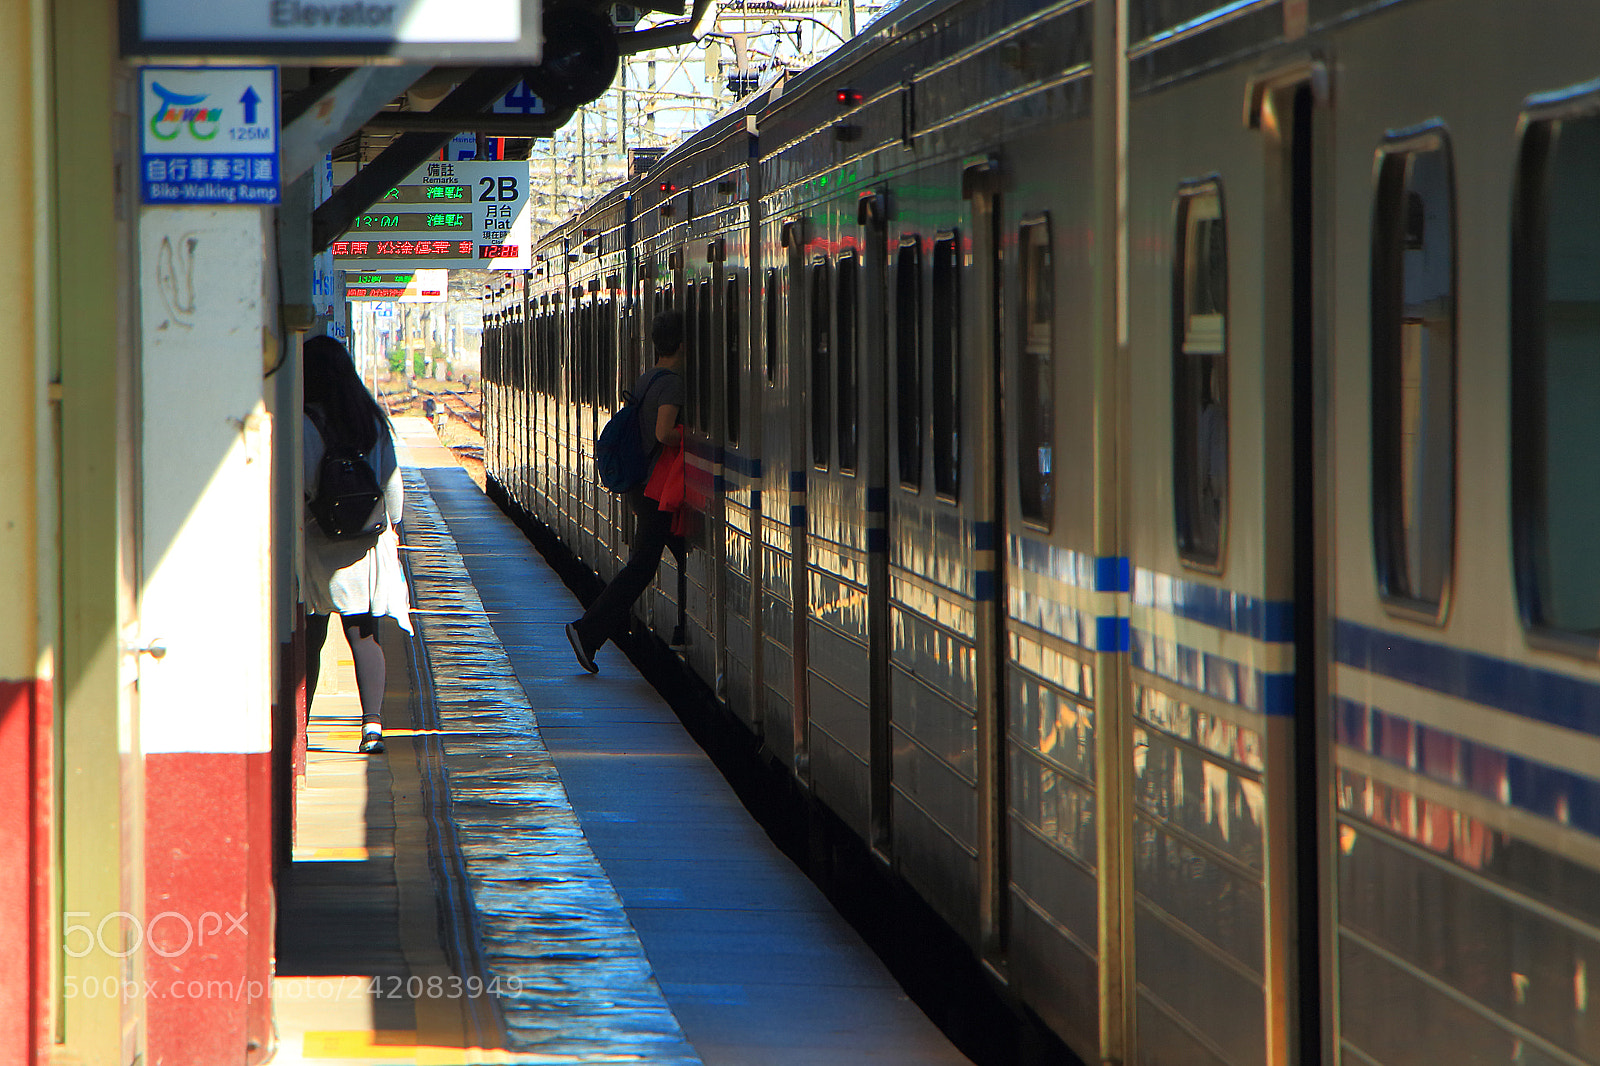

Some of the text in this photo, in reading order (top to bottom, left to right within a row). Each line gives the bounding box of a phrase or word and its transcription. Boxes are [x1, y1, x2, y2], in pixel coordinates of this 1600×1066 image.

[270, 0, 394, 27] Elevator
[504, 79, 536, 114] 4
[229, 127, 270, 140] 125M
[148, 159, 273, 181] 自行車牽引道
[427, 163, 455, 177] 備註
[151, 184, 277, 202] Bike-Walking Ramp
[479, 176, 519, 202] 2B
[486, 204, 512, 218] 月台
[313, 270, 333, 295] Hsi
